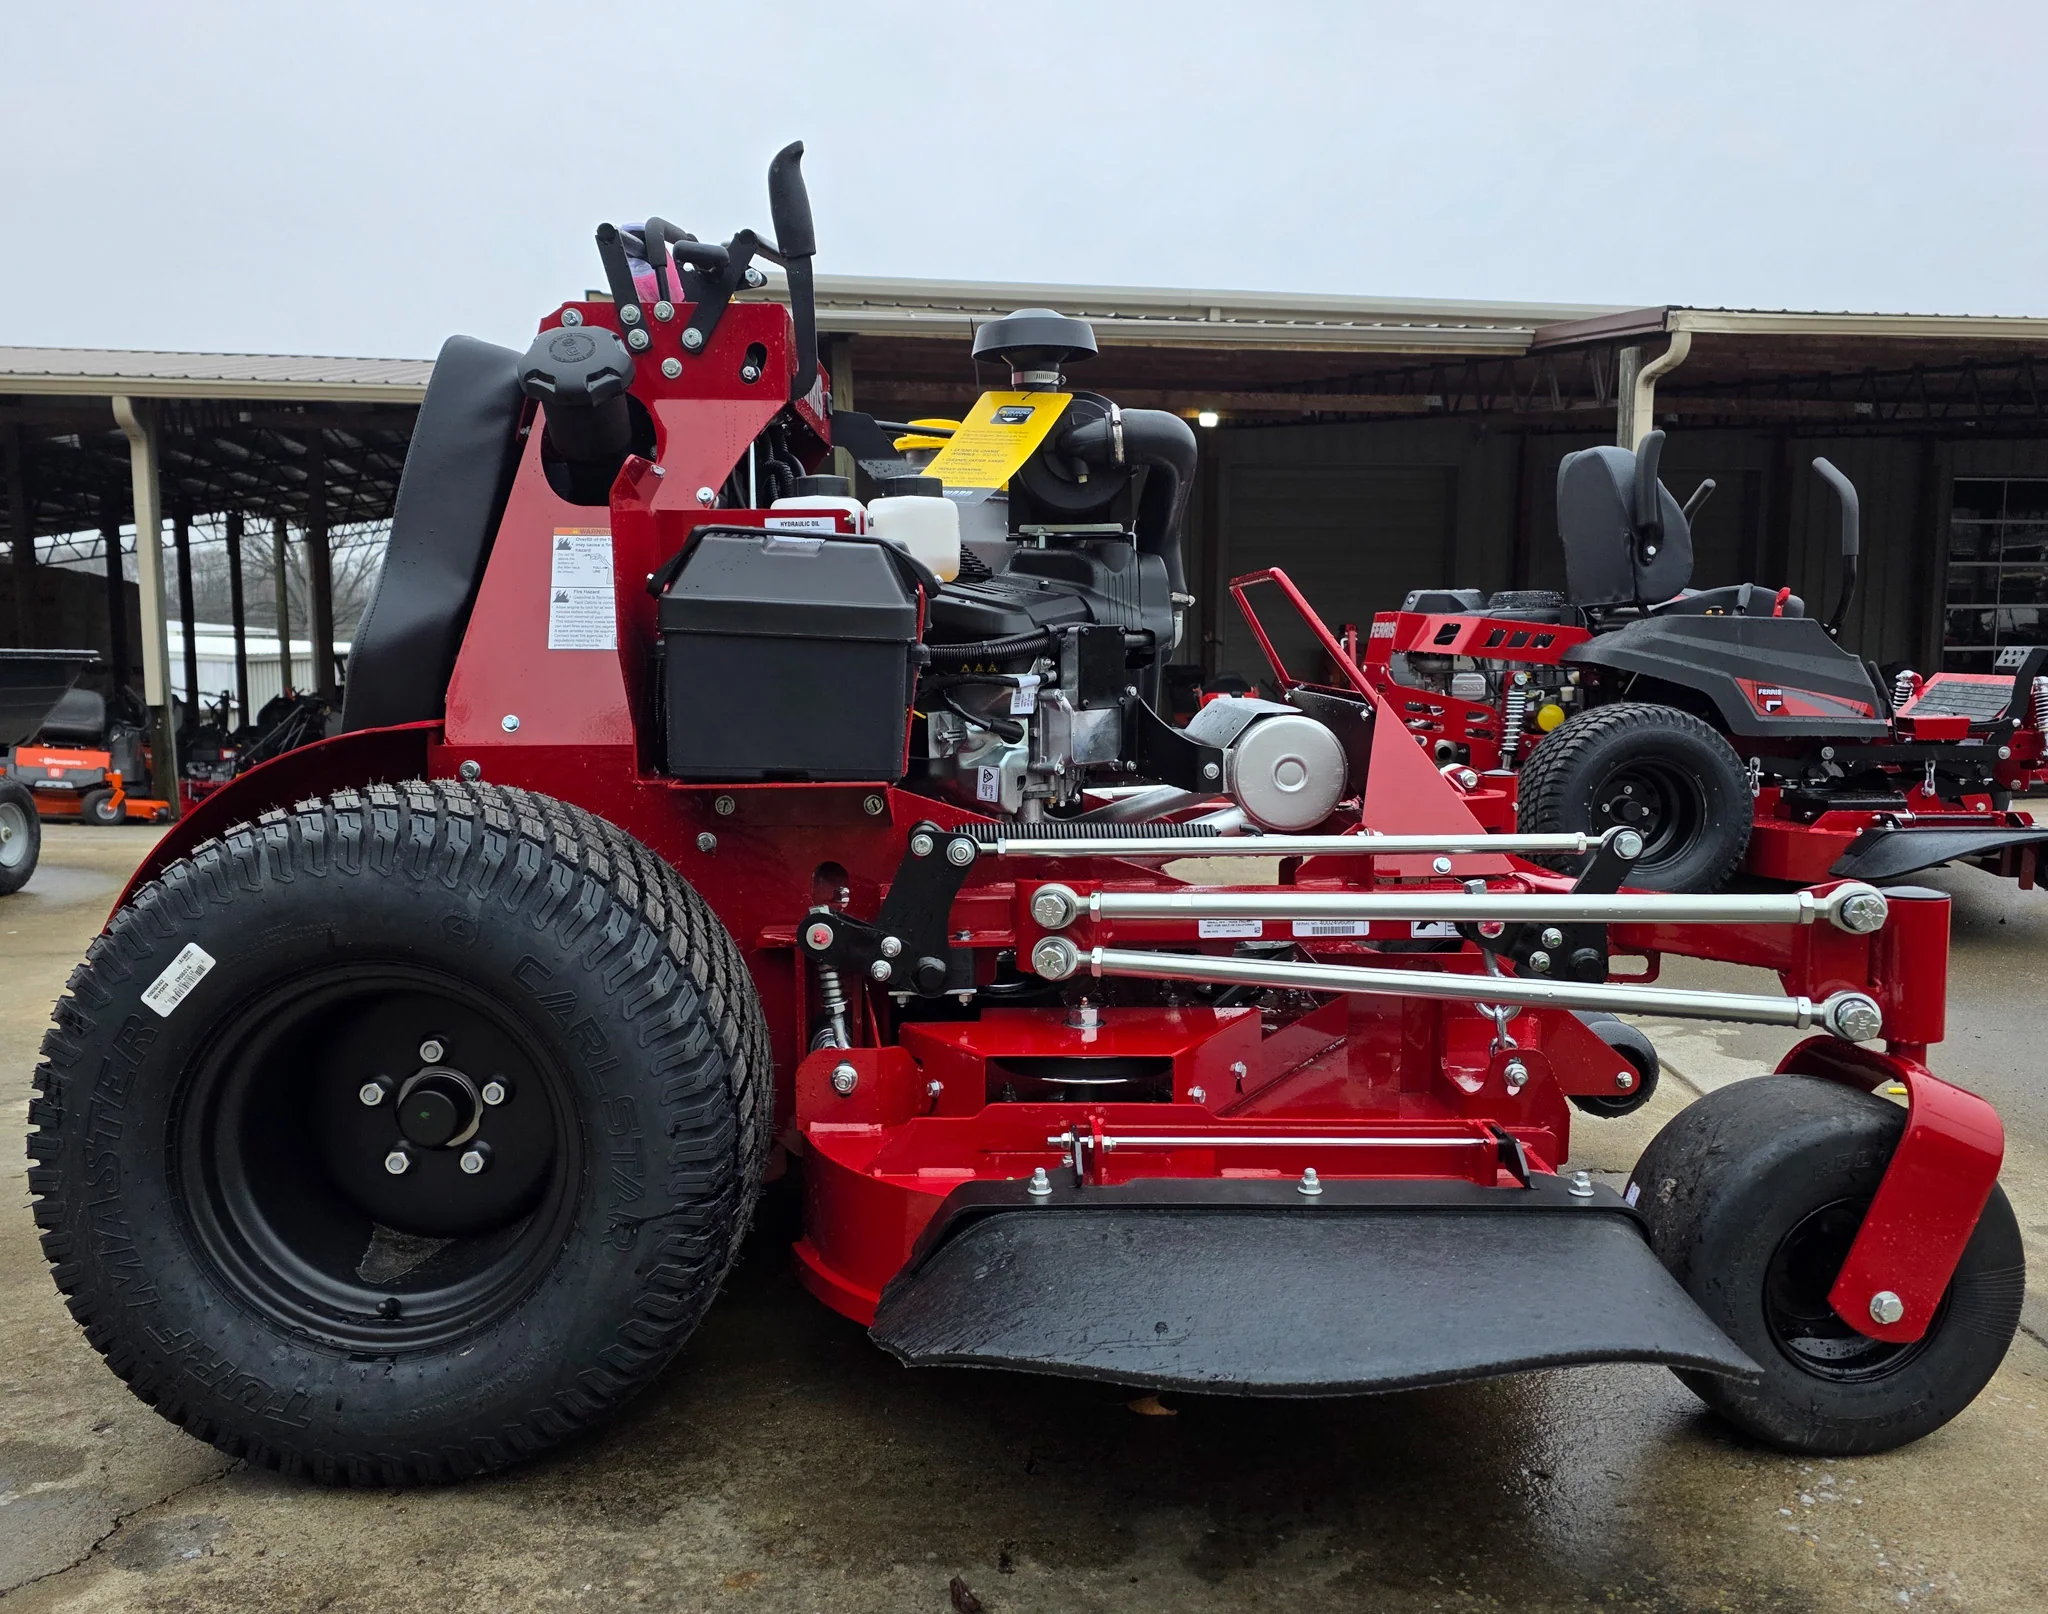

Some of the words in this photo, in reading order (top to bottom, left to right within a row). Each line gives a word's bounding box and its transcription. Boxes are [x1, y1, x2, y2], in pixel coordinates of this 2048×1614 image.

[1370, 622, 1396, 638] FERRIS
[86, 1013, 162, 1308] MASTER
[512, 953, 646, 1252] CARLSTAR
[144, 1325, 312, 1429] TURF
